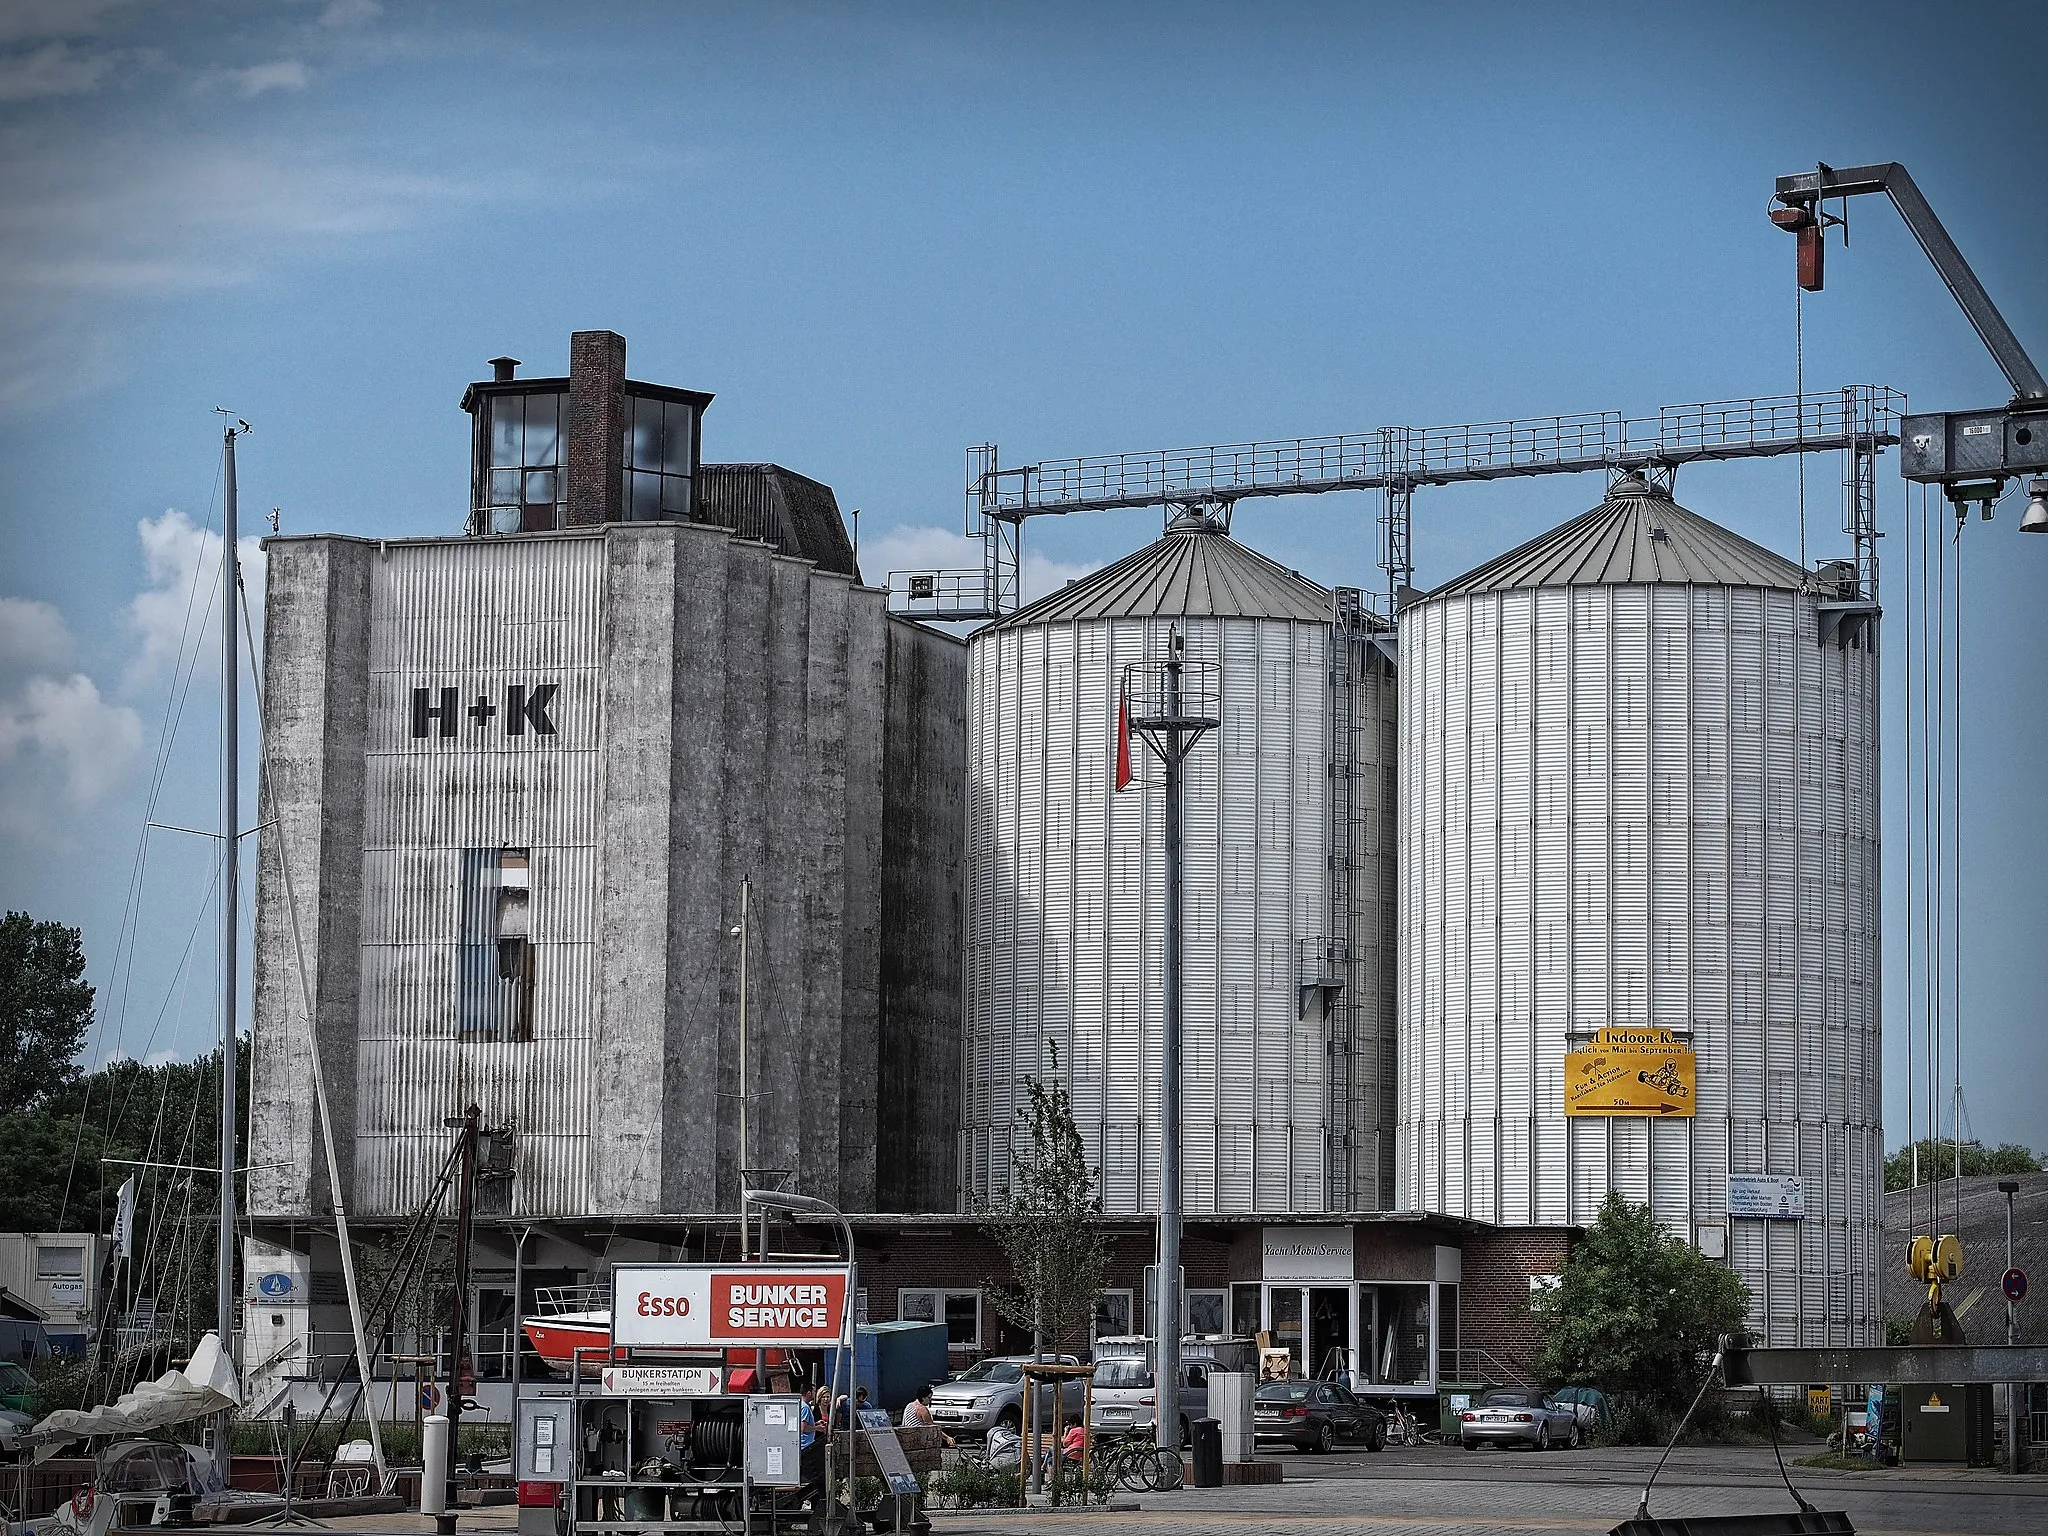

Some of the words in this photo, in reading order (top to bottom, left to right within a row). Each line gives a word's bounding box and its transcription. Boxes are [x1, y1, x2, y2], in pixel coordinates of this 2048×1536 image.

[1264, 1244, 1288, 1256] Yacht
[1290, 1244, 1317, 1255] Mobil
[1319, 1243, 1352, 1255] Service
[51, 1282, 83, 1290] Autogas
[730, 1285, 827, 1305] BUNKER
[728, 1307, 828, 1328] SERVICE
[622, 1369, 702, 1379] BUNKERSTATION
[1810, 1395, 1829, 1404] KART
[1810, 1405, 1829, 1414] BAHN
